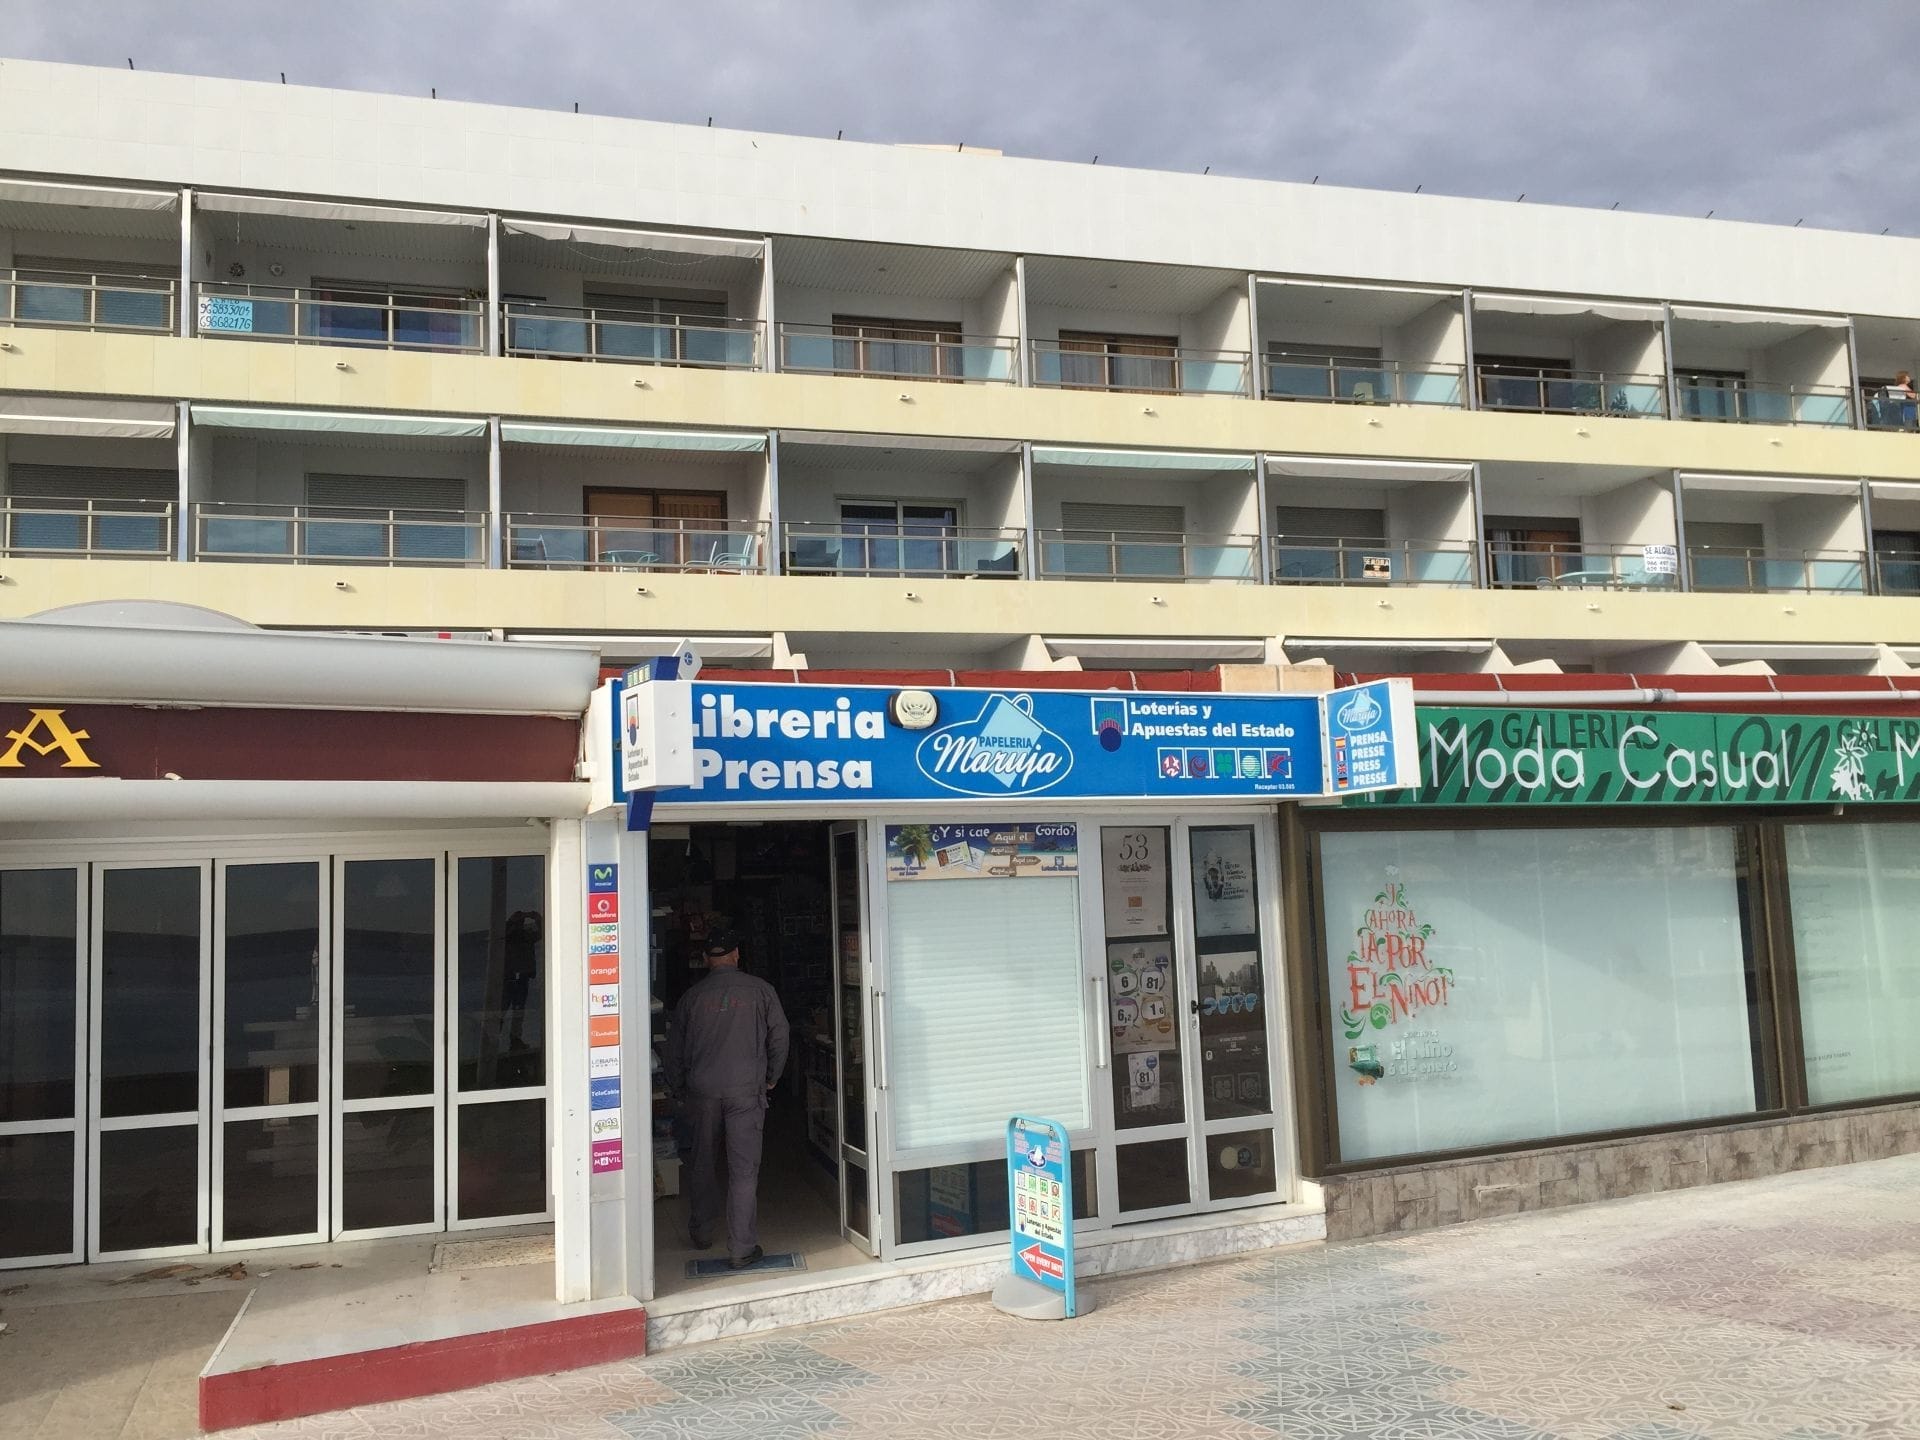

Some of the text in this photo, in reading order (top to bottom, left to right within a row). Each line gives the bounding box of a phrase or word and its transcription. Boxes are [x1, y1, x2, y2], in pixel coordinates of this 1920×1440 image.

[1131, 702, 1212, 719] Loterías y
[1132, 722, 1295, 740] Apuestas del Estado
[1501, 713, 1660, 749] GALERIAS
[979, 736, 1034, 749] PAPELERIA
[1350, 731, 1388, 747] PRENSA
[1351, 745, 1385, 760] PRESSE
[1429, 723, 1585, 789] Moda
[1619, 725, 1790, 788] Casual
[933, 734, 1062, 788] Maruja
[1352, 760, 1380, 773] PRESS
[690, 749, 873, 790] Prensa
[1353, 772, 1386, 786] PRESSE
[955, 826, 964, 838] si
[969, 828, 990, 837] cae
[1035, 824, 1076, 836] Gordo?
[1019, 833, 1028, 841] el
[1119, 834, 1149, 860] 53
[591, 924, 617, 933] yoigo
[591, 934, 617, 943] yoigo
[591, 944, 617, 953] yoigo
[1121, 976, 1129, 989] 6
[1146, 977, 1159, 990] 81
[1140, 1072, 1149, 1083] 81
